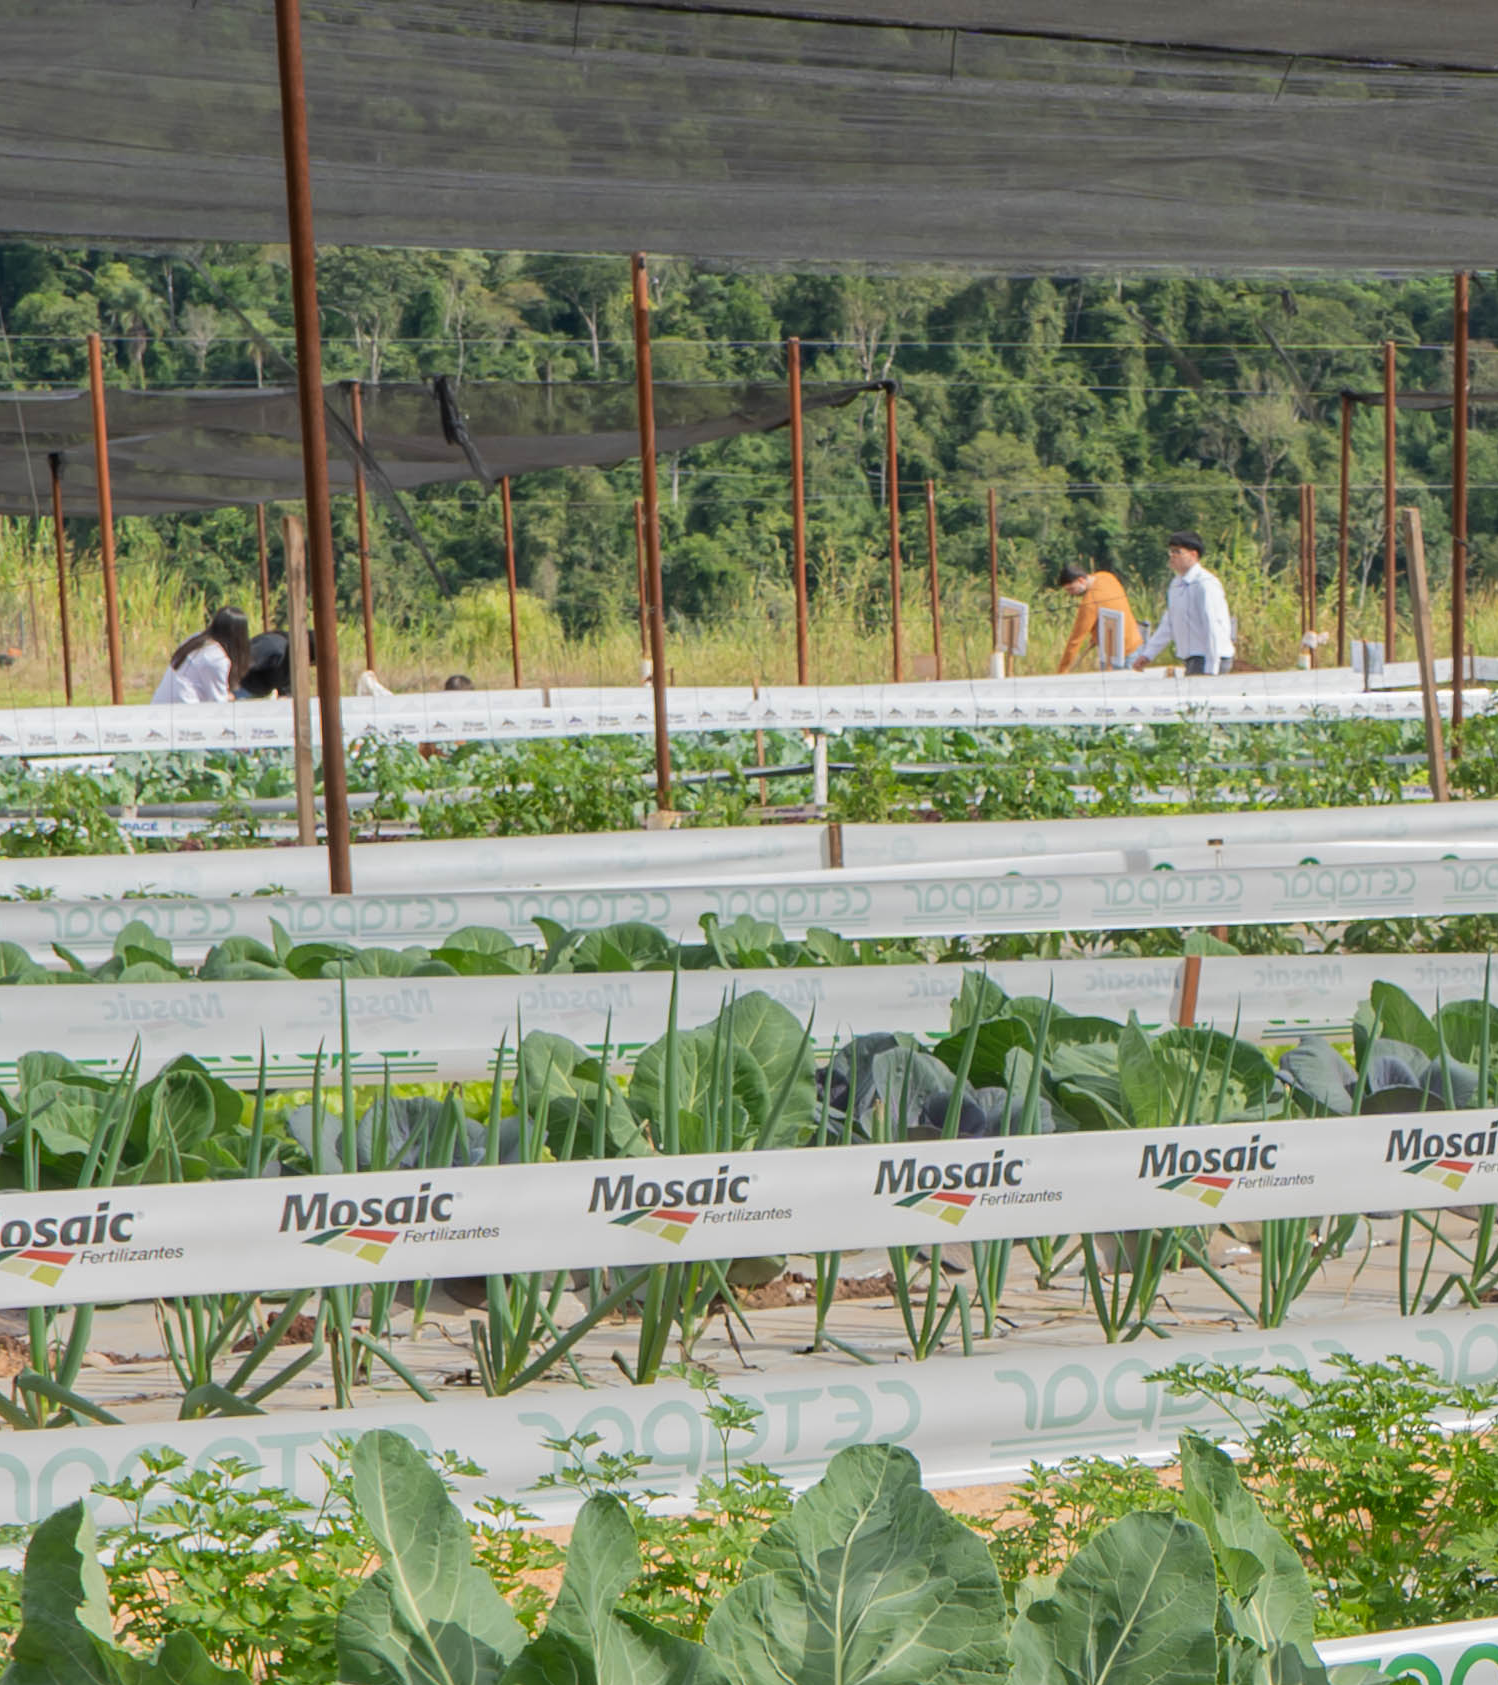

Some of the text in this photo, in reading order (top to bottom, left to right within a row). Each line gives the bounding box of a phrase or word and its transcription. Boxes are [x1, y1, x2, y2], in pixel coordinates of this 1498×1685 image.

[1138, 1135, 1278, 1181] Mosaic
[874, 1149, 1023, 1197] Mosaic
[1236, 1171, 1316, 1191] Fertilizantes
[587, 1164, 750, 1213] Mosaic
[979, 1187, 1064, 1208] Fertilizantes
[280, 1182, 455, 1235] Mosaic
[702, 1204, 794, 1225] Fertilizantes
[402, 1224, 501, 1245] Fertilizantes
[78, 1243, 185, 1267] Fertilizantes
